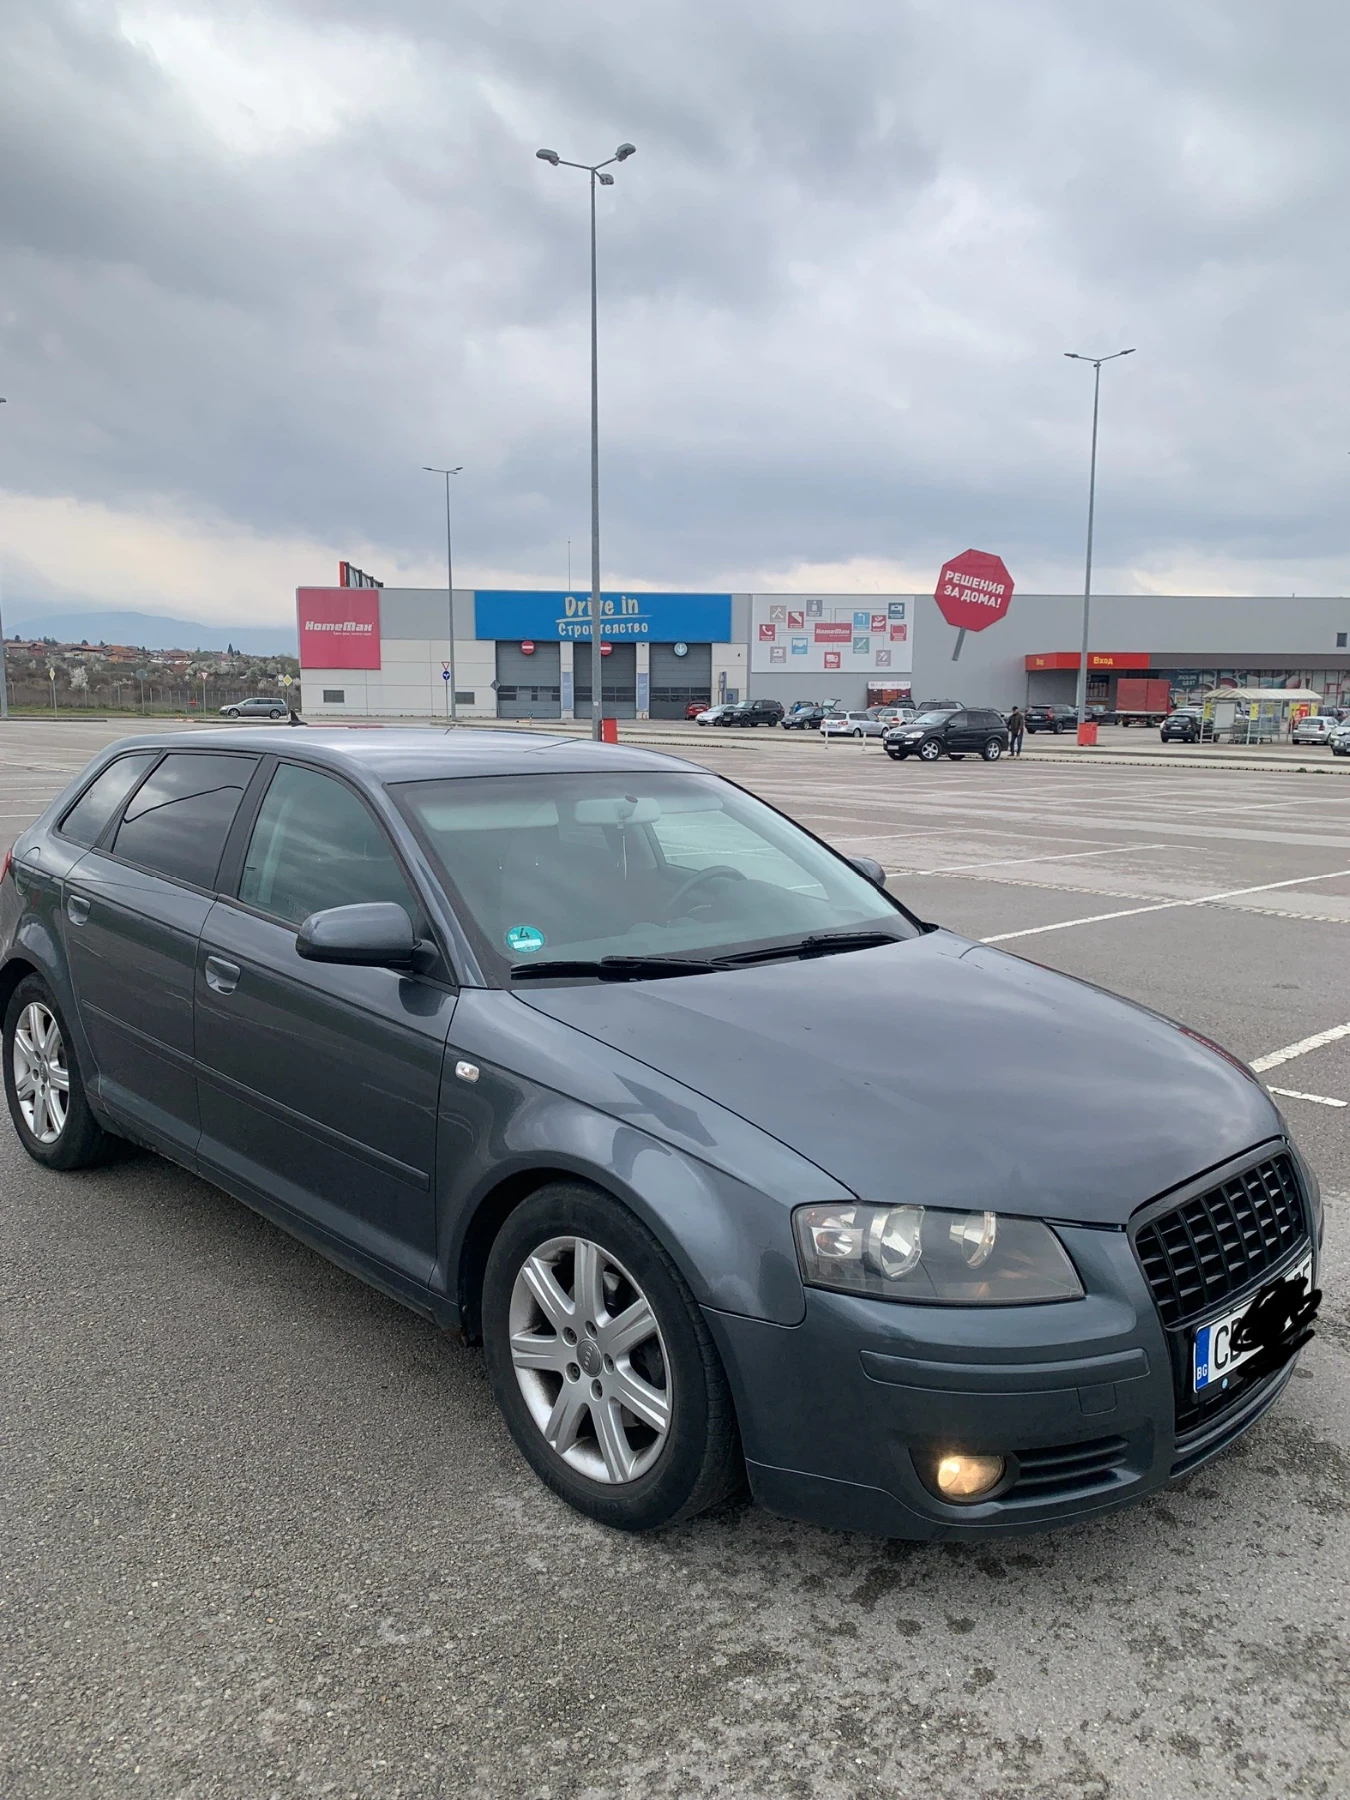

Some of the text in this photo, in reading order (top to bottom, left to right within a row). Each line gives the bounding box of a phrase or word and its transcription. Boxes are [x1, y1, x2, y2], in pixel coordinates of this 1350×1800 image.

[945, 570, 1005, 595] РЕШЕНИЯ
[621, 595, 639, 615] in
[944, 585, 1002, 608] ЗА ДОМА!
[305, 620, 373, 632] HomeMax
[1093, 656, 1113, 665] Вход
[1197, 1363, 1208, 1381] BG
